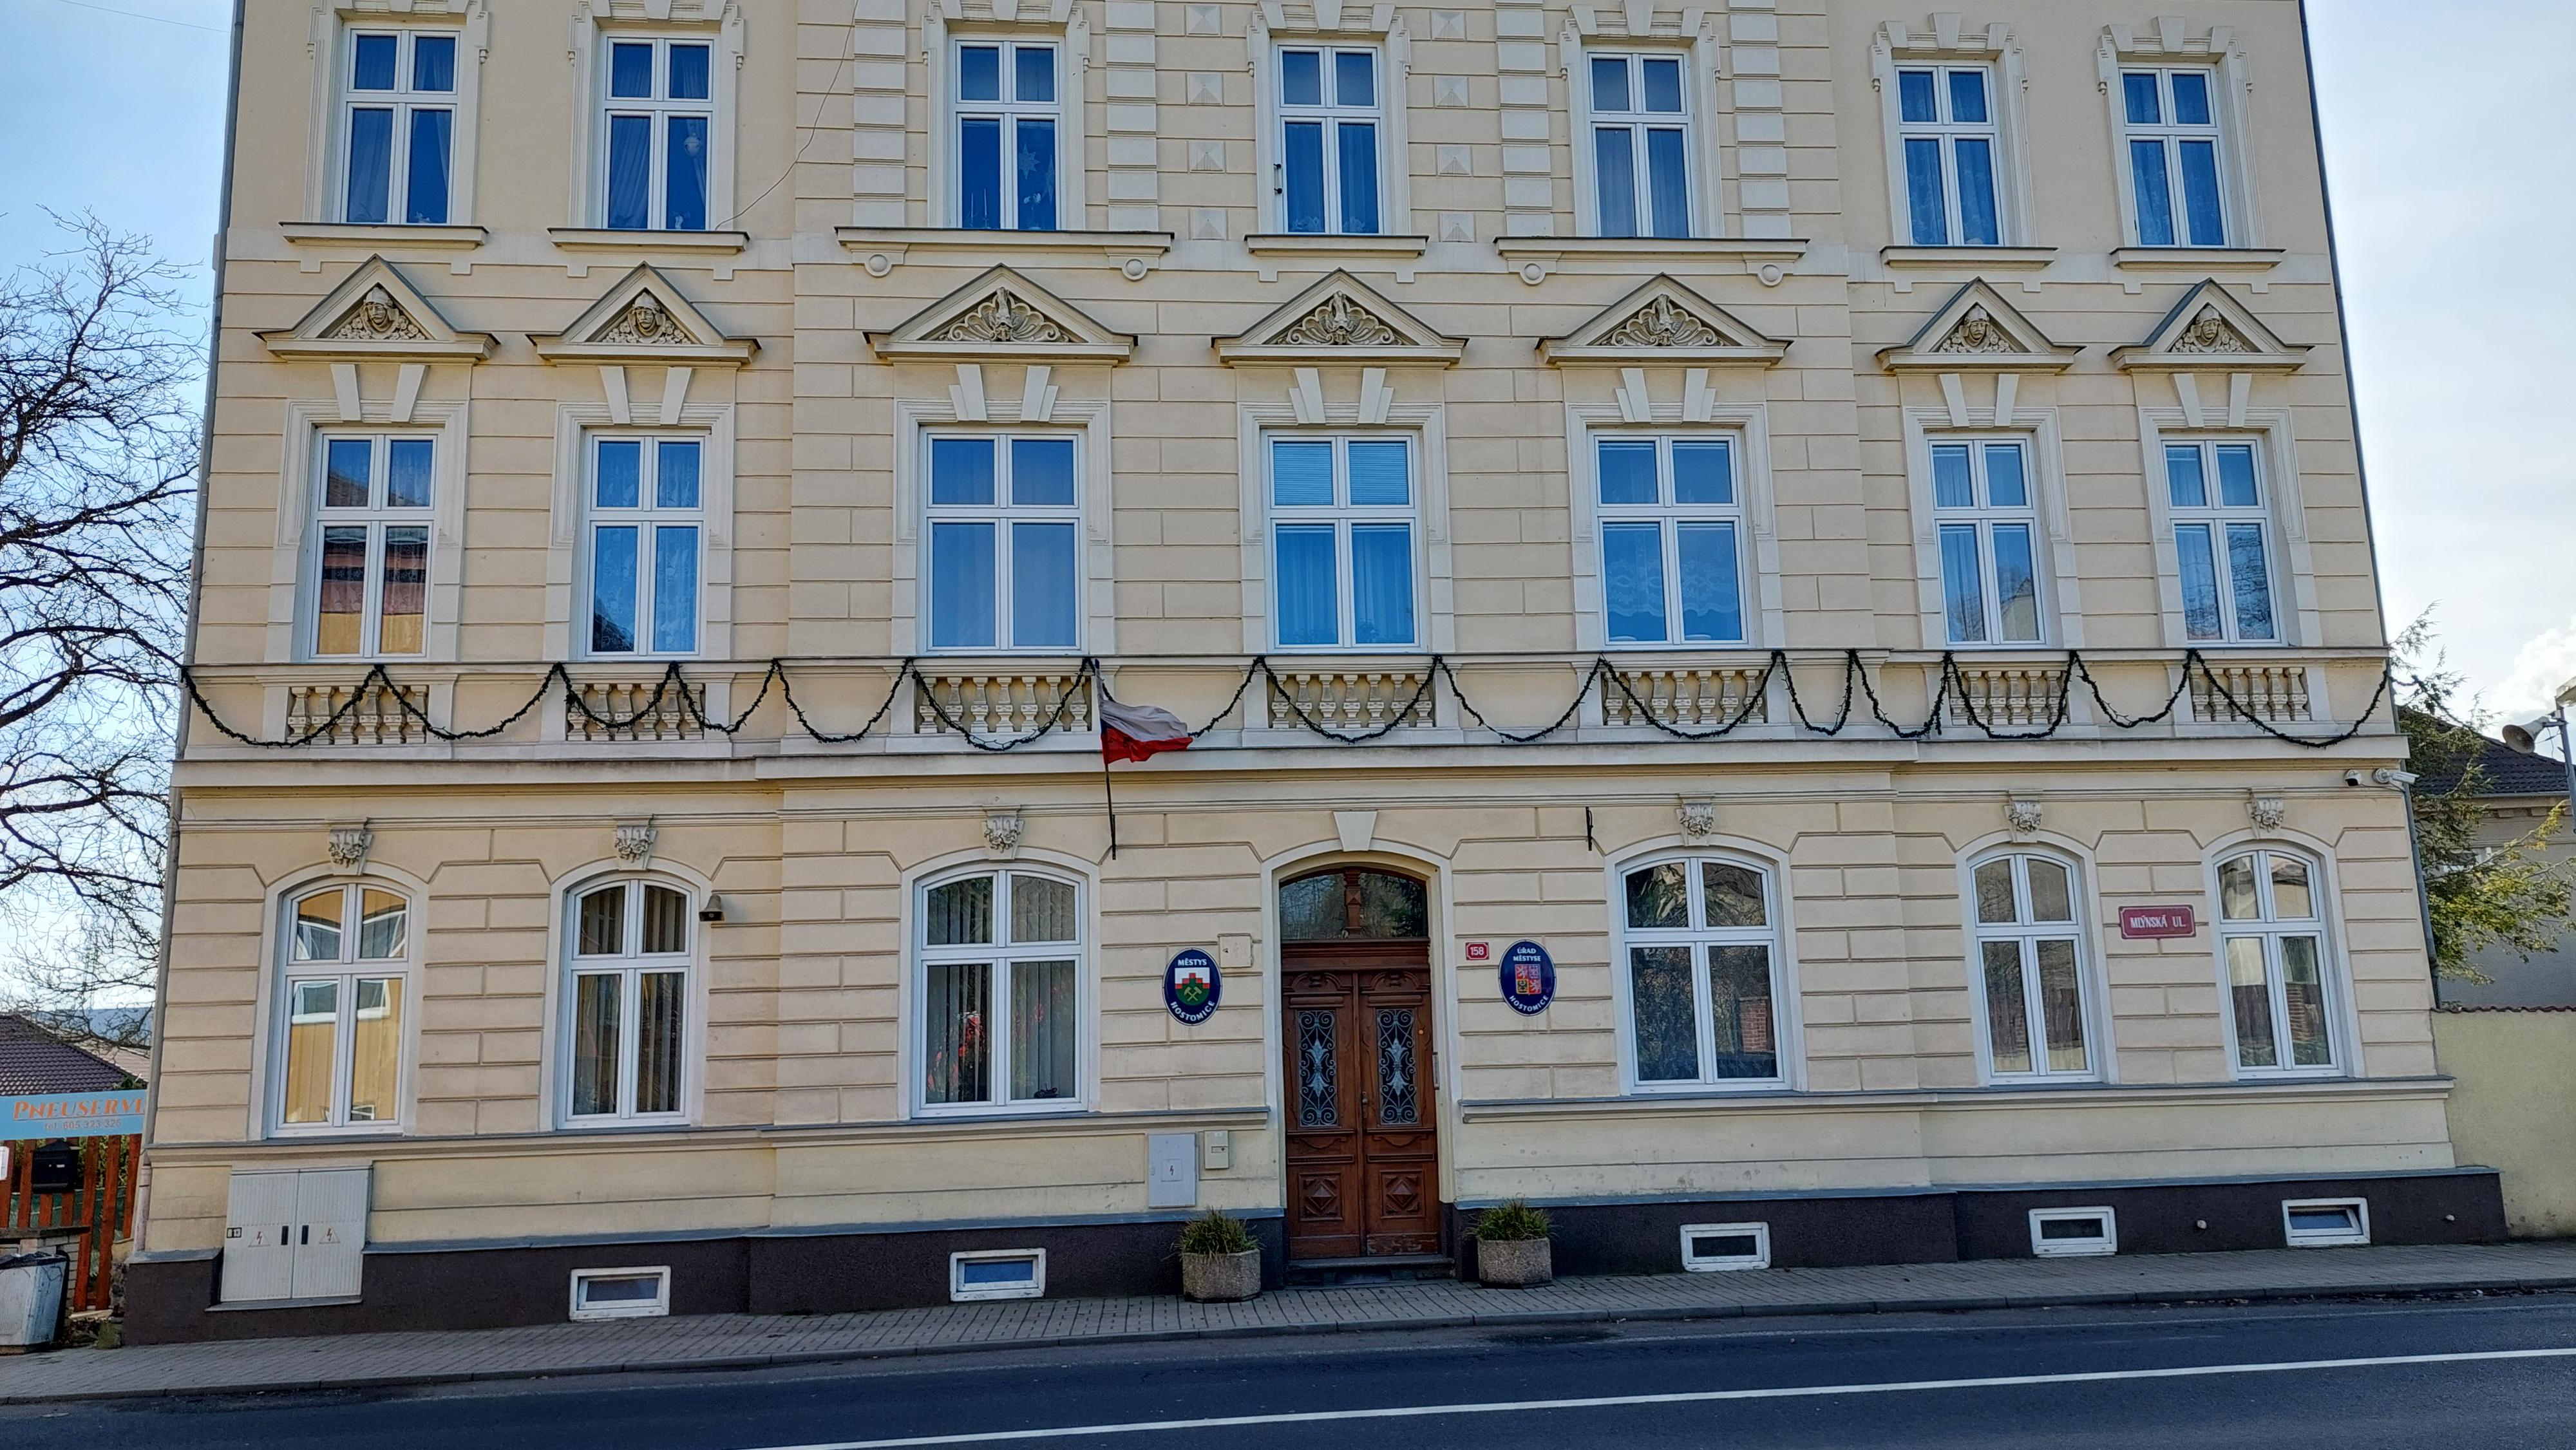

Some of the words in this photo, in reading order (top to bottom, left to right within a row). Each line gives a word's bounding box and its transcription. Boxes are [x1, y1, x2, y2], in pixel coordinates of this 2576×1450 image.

[2130, 915, 2168, 928] MLÝNSKÁ
[2172, 916, 2186, 927] UL.
[1470, 946, 1484, 956] 158
[1178, 958, 1207, 966] MĚSTYS
[1170, 1001, 1215, 1021] HOSTOMICE
[1509, 995, 1549, 1012] HOSTOMICE
[14, 1098, 145, 1120] PNEUSERVI
